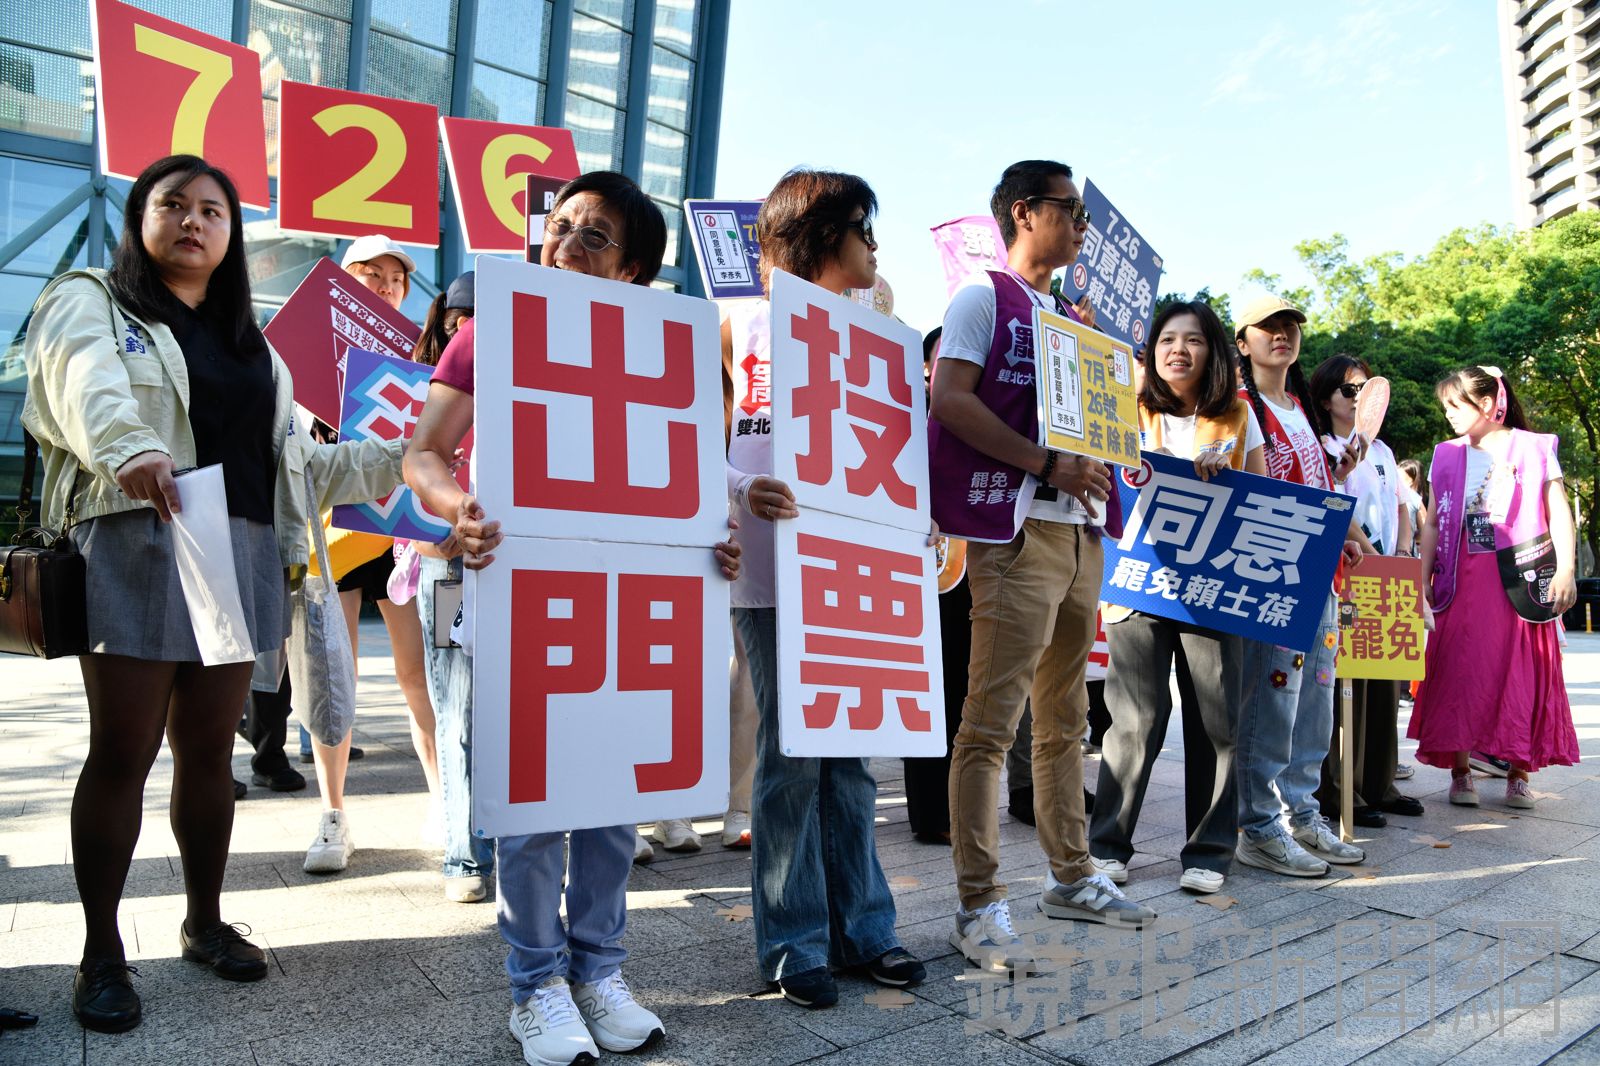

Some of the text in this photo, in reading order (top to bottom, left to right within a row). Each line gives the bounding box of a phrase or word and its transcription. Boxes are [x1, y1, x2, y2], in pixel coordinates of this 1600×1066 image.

[134, 23, 234, 156] 7
[311, 104, 413, 229] 2
[481, 134, 553, 239] 6
[1106, 210, 1141, 261] 7.26
[1080, 223, 1153, 319] 同意罷免
[1087, 275, 1133, 334] 賴士葆
[995, 367, 1035, 386] 雙北大
[1084, 358, 1106, 390] 7月
[1086, 389, 1119, 423] 26號
[971, 471, 1008, 488] 罷免
[1117, 472, 1328, 586] 同意
[1108, 556, 1299, 629] 罷免賴士葆
[1338, 576, 1420, 619] 要投
[1336, 618, 1421, 661] 罷免
